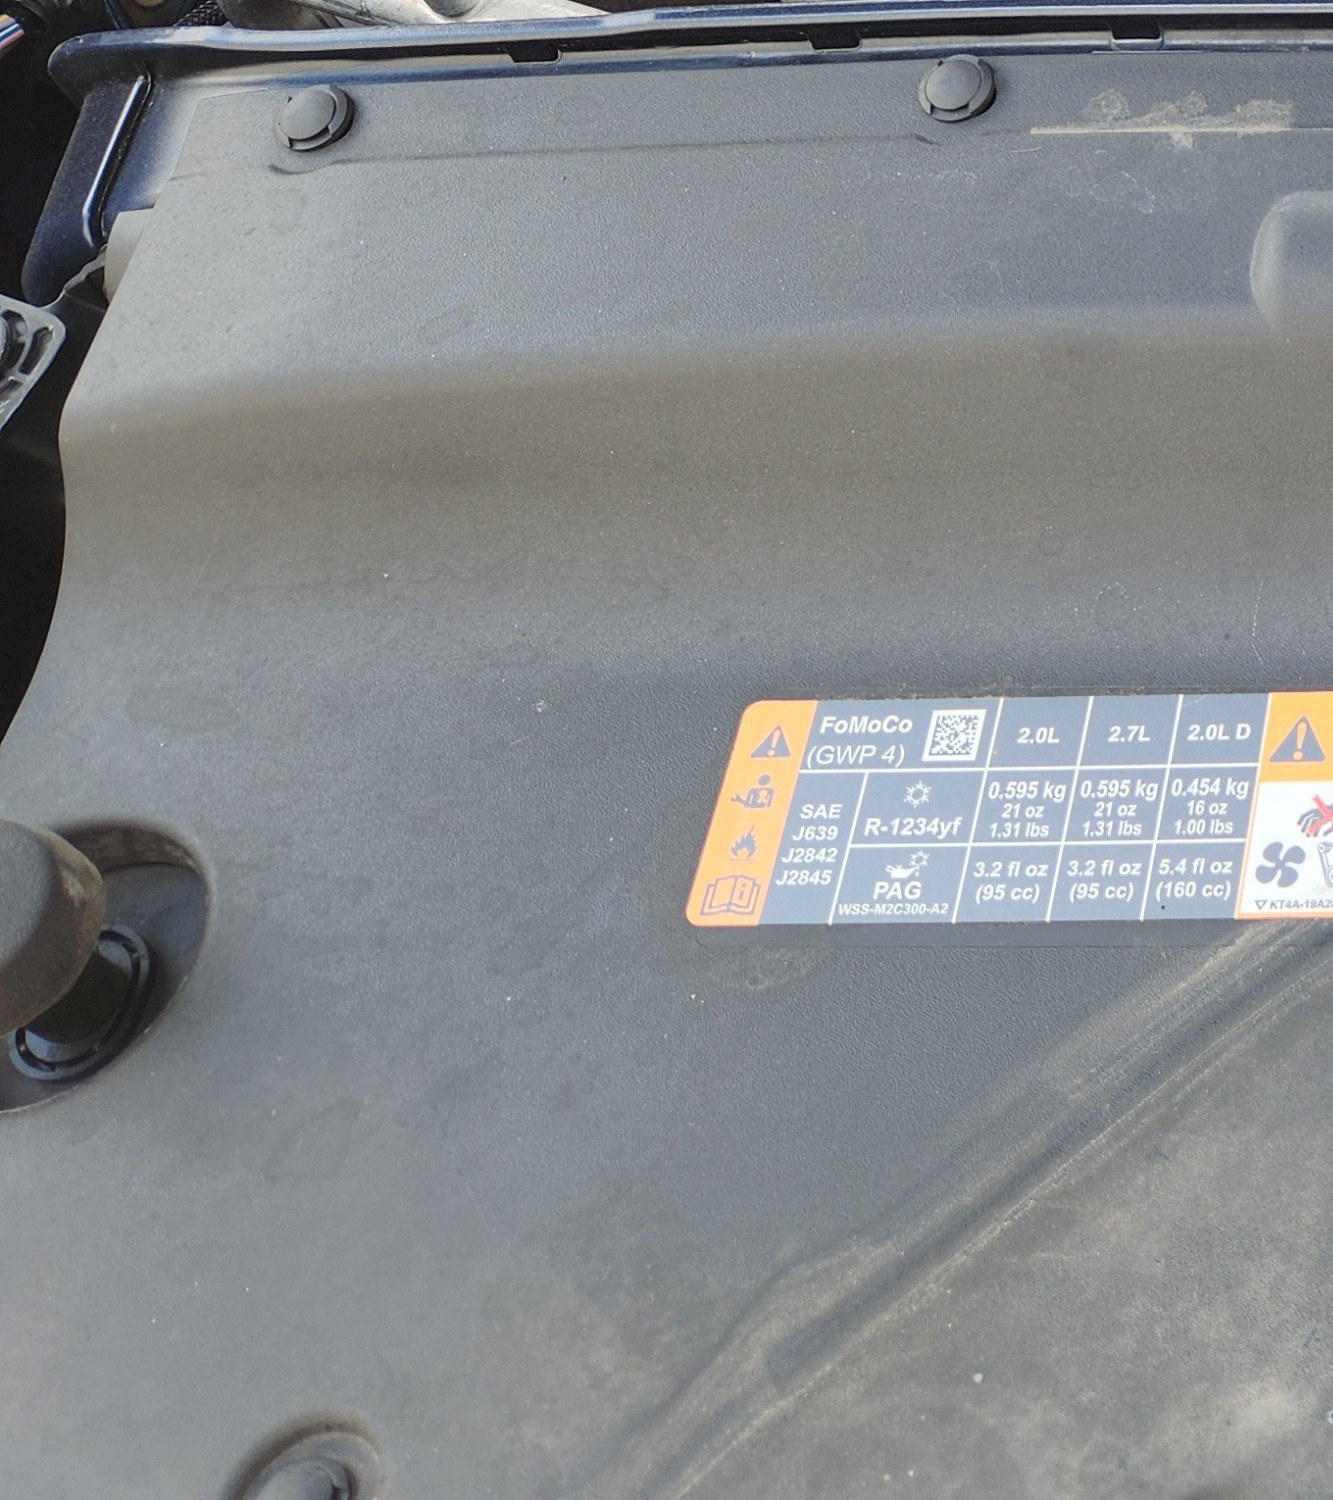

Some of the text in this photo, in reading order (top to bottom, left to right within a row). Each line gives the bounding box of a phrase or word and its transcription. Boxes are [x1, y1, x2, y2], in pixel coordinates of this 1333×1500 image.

[819, 716, 913, 734] FoMoCo
[1187, 724, 1251, 741] 2.0L D
[1017, 728, 1060, 744] 2.0L
[1108, 726, 1151, 742] 2.7L
[807, 744, 905, 769] (GWP 4)
[988, 781, 1066, 802] 0.595 kg
[1080, 780, 1158, 800] 0.595 kg
[1171, 778, 1249, 799] 0.454 kg
[799, 804, 842, 819] SAE
[1002, 804, 1044, 818] 21 oz
[1094, 803, 1136, 817] 21 oz
[1187, 801, 1228, 816] 16 oz
[792, 825, 838, 841] J639
[864, 816, 963, 839] R-1234yf
[990, 823, 1049, 839] 1.31 lbs
[1082, 821, 1142, 837] 1.31 lbs
[1173, 818, 1233, 835] 1.00 lbs
[781, 848, 838, 863] J2842
[973, 861, 1048, 878] 3.2 fl oz
[1067, 859, 1142, 876] 3.2 fl oz
[1158, 858, 1233, 875] 5.4 fl oz
[775, 870, 832, 885] J2845
[873, 882, 922, 899] PAG
[975, 884, 1040, 903] (95 cc)
[1069, 882, 1134, 902] (95 cc)
[1155, 881, 1232, 900] (160 cc)
[838, 903, 949, 916] WSS-M2C300-A2
